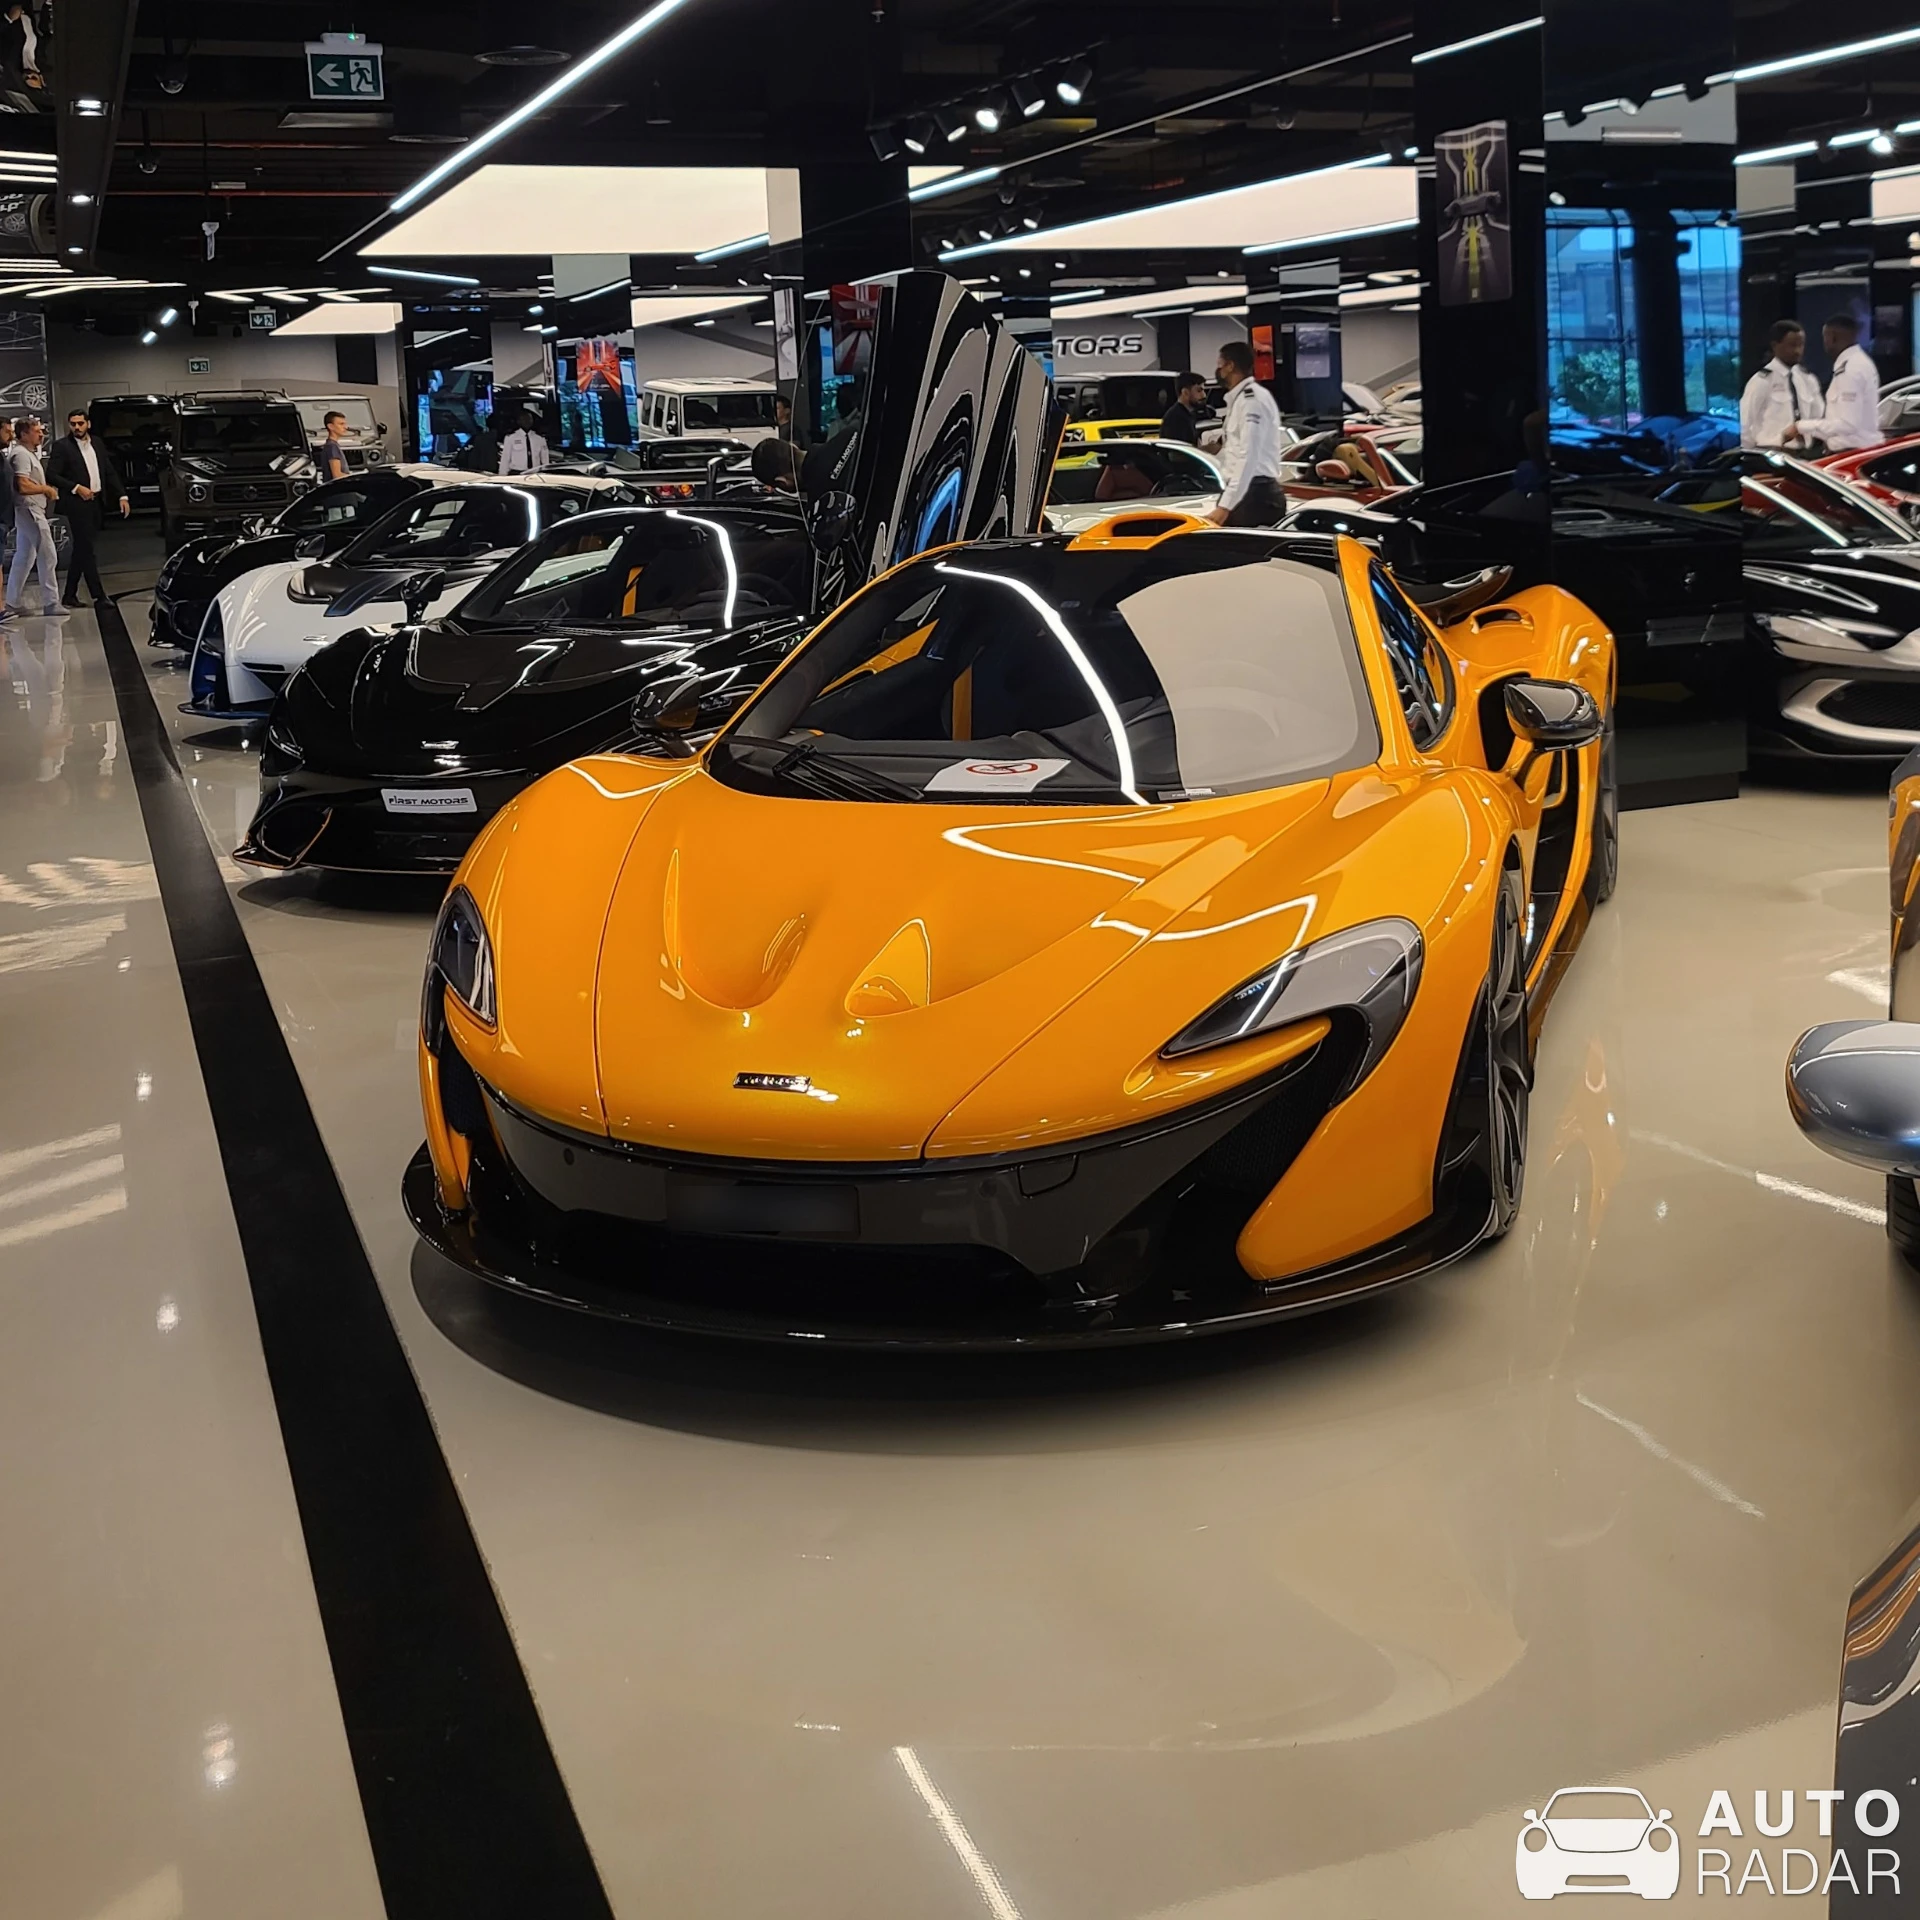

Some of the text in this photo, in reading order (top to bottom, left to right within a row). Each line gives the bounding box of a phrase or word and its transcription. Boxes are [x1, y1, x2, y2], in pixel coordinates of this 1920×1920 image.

[830, 460, 843, 480] FRST
[388, 795, 469, 805] FIRST MOTORS
